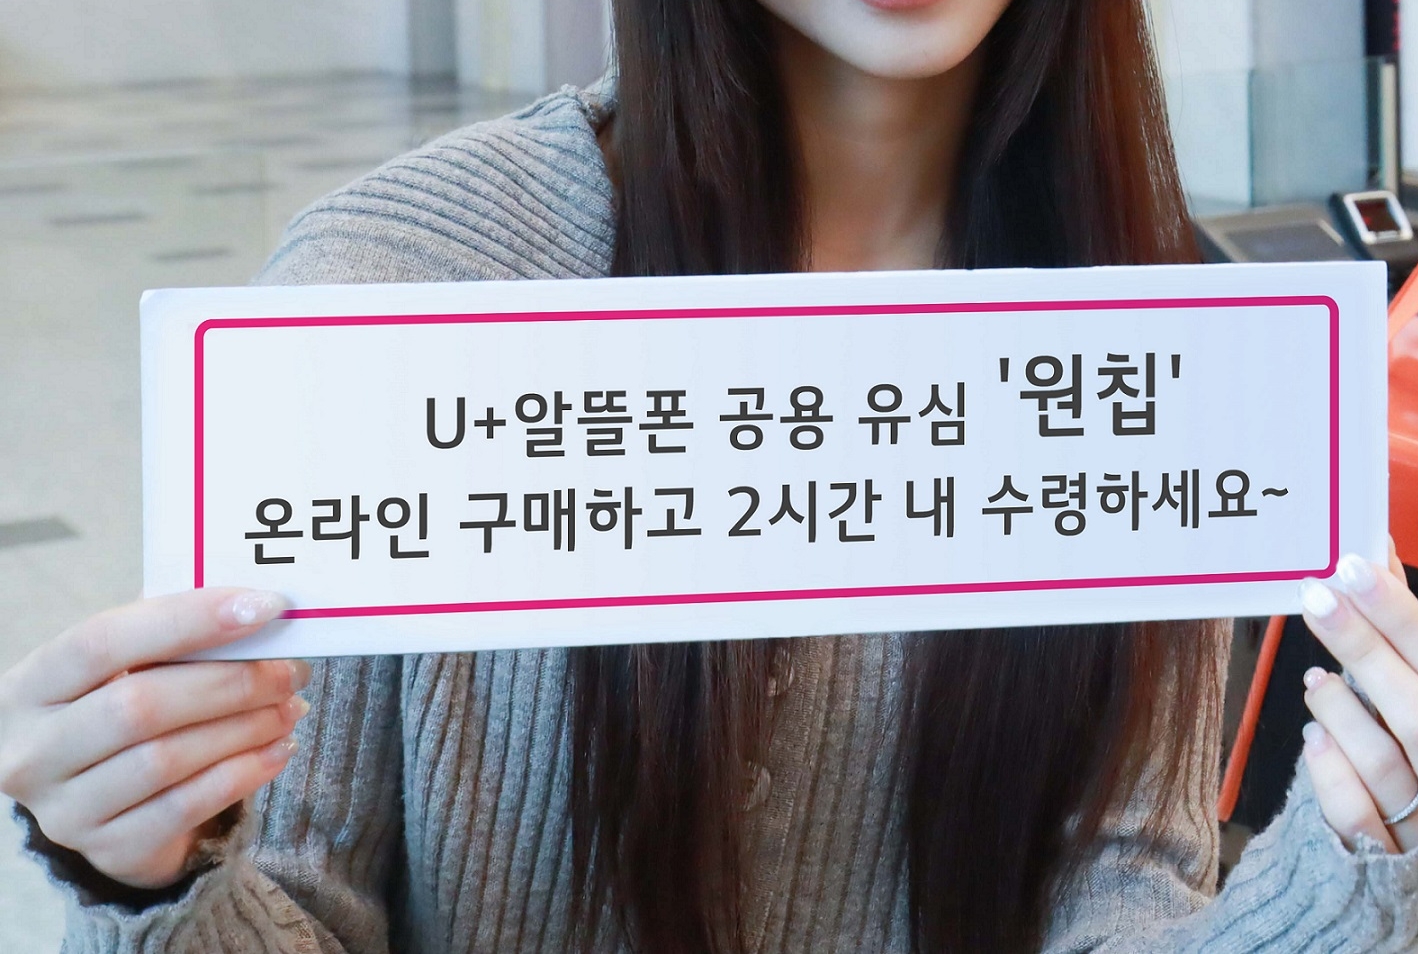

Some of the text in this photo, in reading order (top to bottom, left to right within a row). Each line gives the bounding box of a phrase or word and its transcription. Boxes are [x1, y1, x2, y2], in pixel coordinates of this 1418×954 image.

[426, 352, 1181, 458] U+알뜰폰 공용 유심 '원칩'
[244, 468, 1289, 565] 온라인 구매하고 2시간 내 수령하세요~
